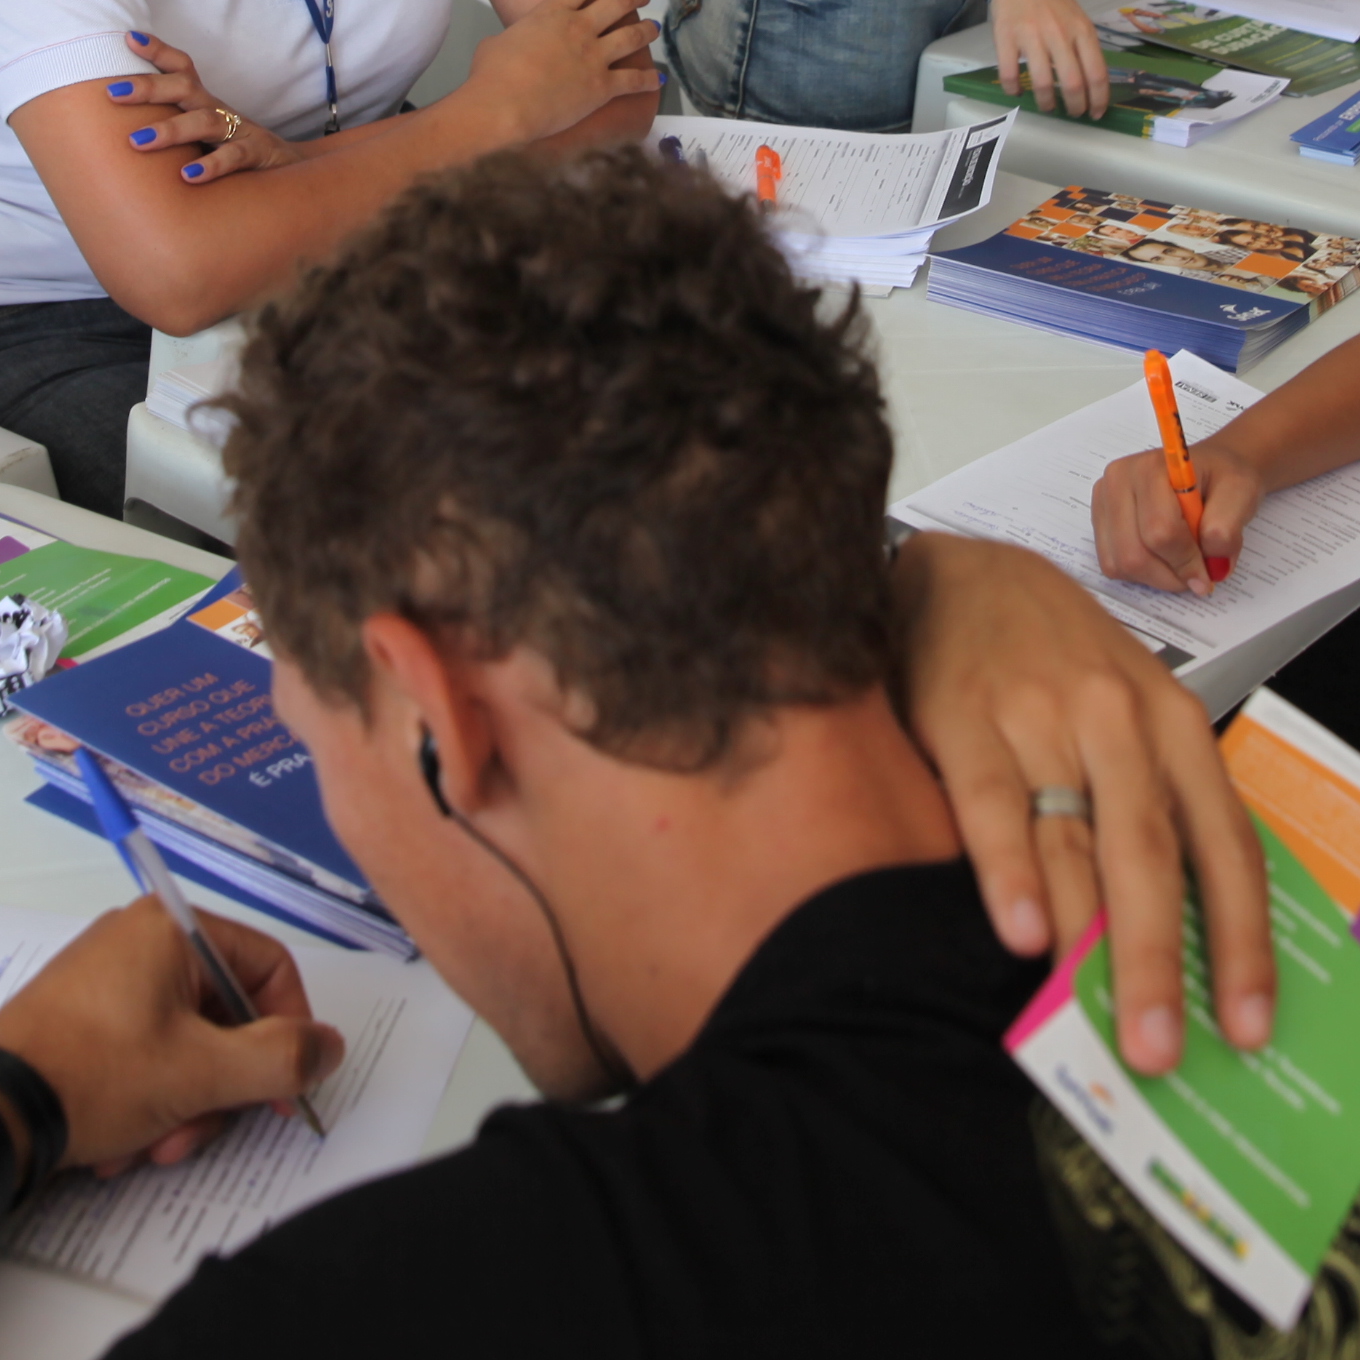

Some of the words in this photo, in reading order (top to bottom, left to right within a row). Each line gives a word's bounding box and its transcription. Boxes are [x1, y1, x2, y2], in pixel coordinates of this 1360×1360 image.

[125, 686, 185, 717] QUER
[181, 672, 220, 692] UM
[137, 699, 210, 736] CURSO
[208, 679, 256, 704] QUE
[151, 727, 202, 755] UNE
[199, 721, 220, 734] A
[168, 742, 223, 773] COM
[221, 736, 242, 749] A
[197, 762, 237, 786] DO
